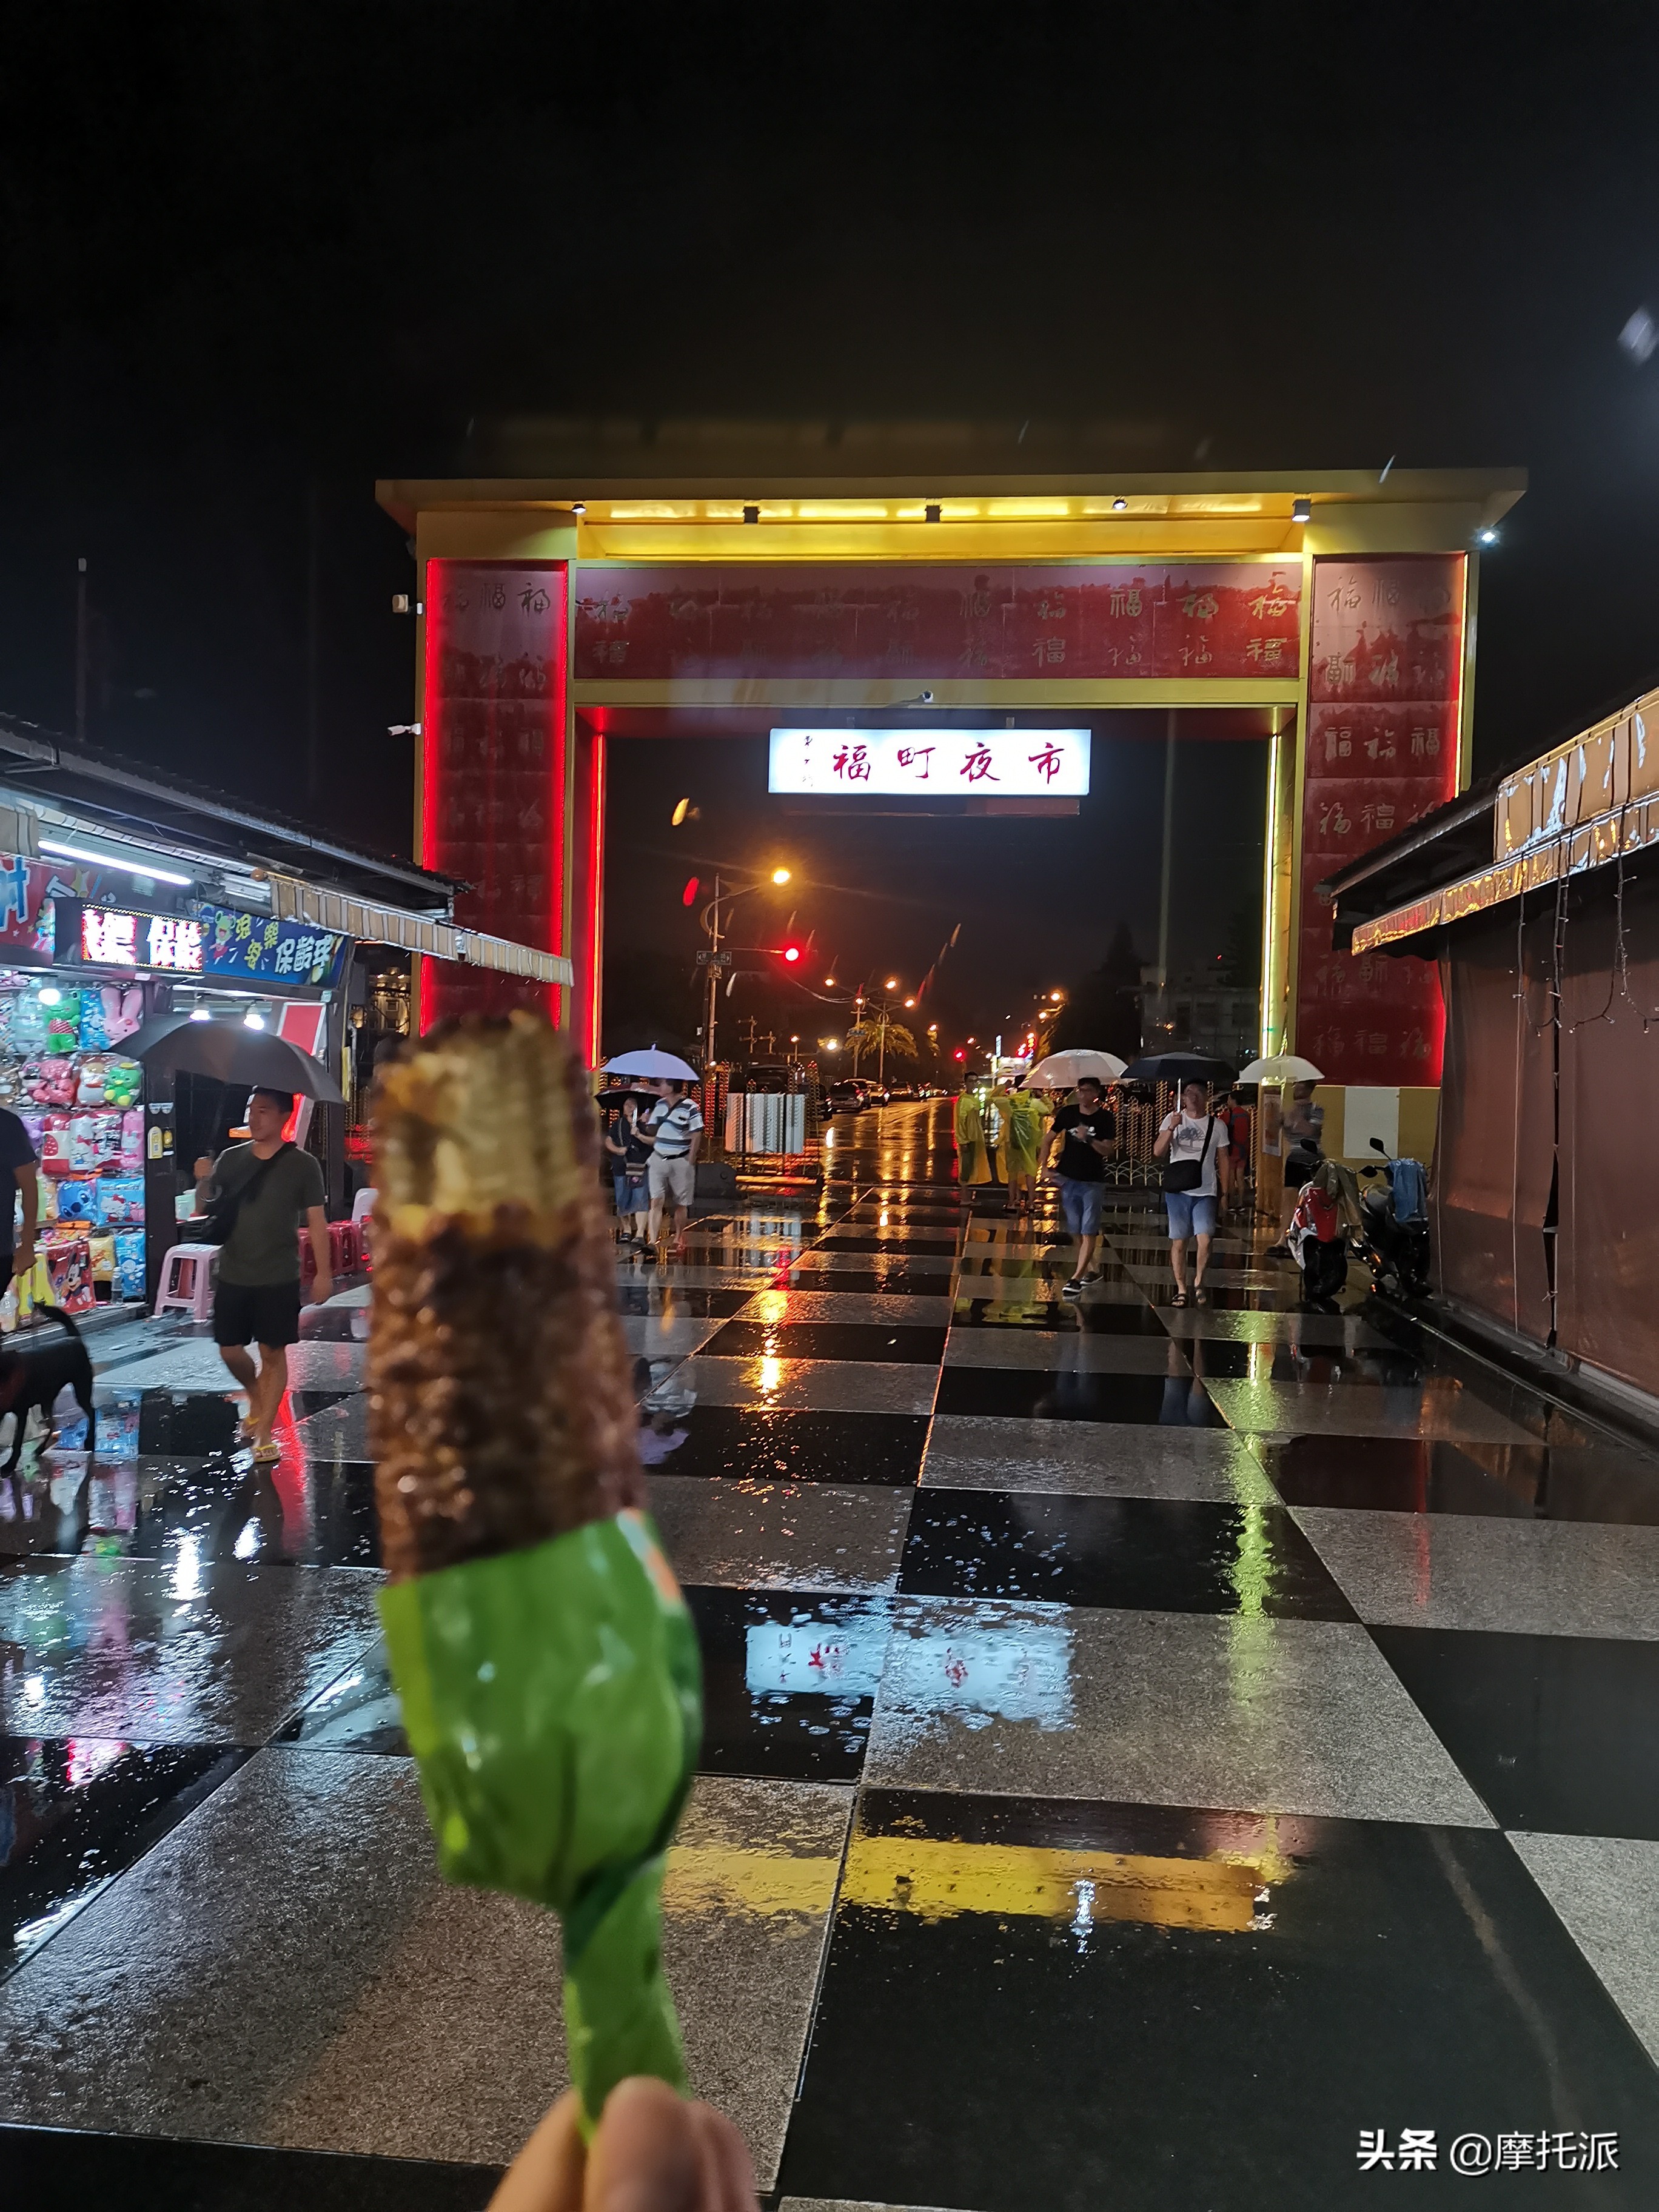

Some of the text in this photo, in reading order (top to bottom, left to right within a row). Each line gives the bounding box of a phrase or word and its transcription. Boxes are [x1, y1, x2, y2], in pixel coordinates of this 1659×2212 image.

[1110, 588, 1142, 619] 福
[1032, 635, 1067, 669] 福
[833, 742, 1065, 785] 福町夜市
